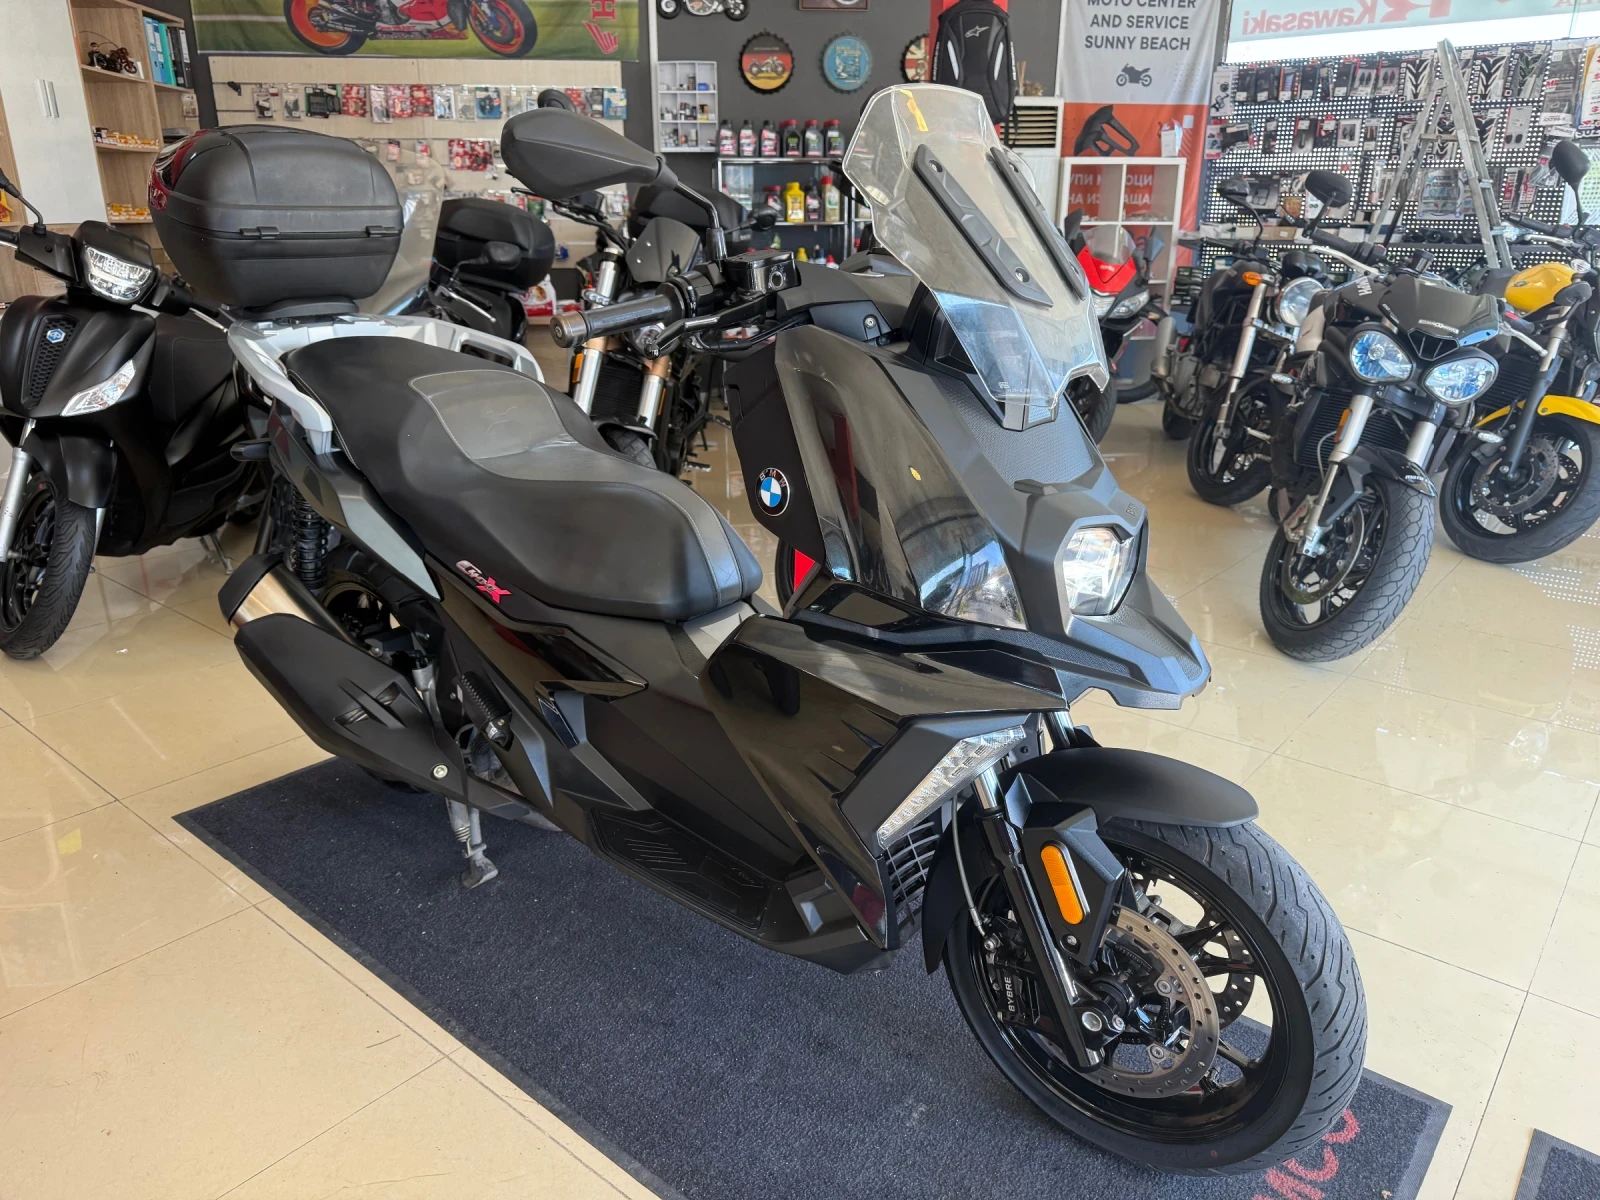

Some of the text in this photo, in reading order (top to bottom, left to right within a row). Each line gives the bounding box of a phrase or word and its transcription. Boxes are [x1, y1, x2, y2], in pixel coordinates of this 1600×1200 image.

[1089, 14, 1189, 29] AND SERVICE
[1084, 35, 1191, 51] SUNNY BEACH
[1004, 976, 1016, 1012] BYBRE
